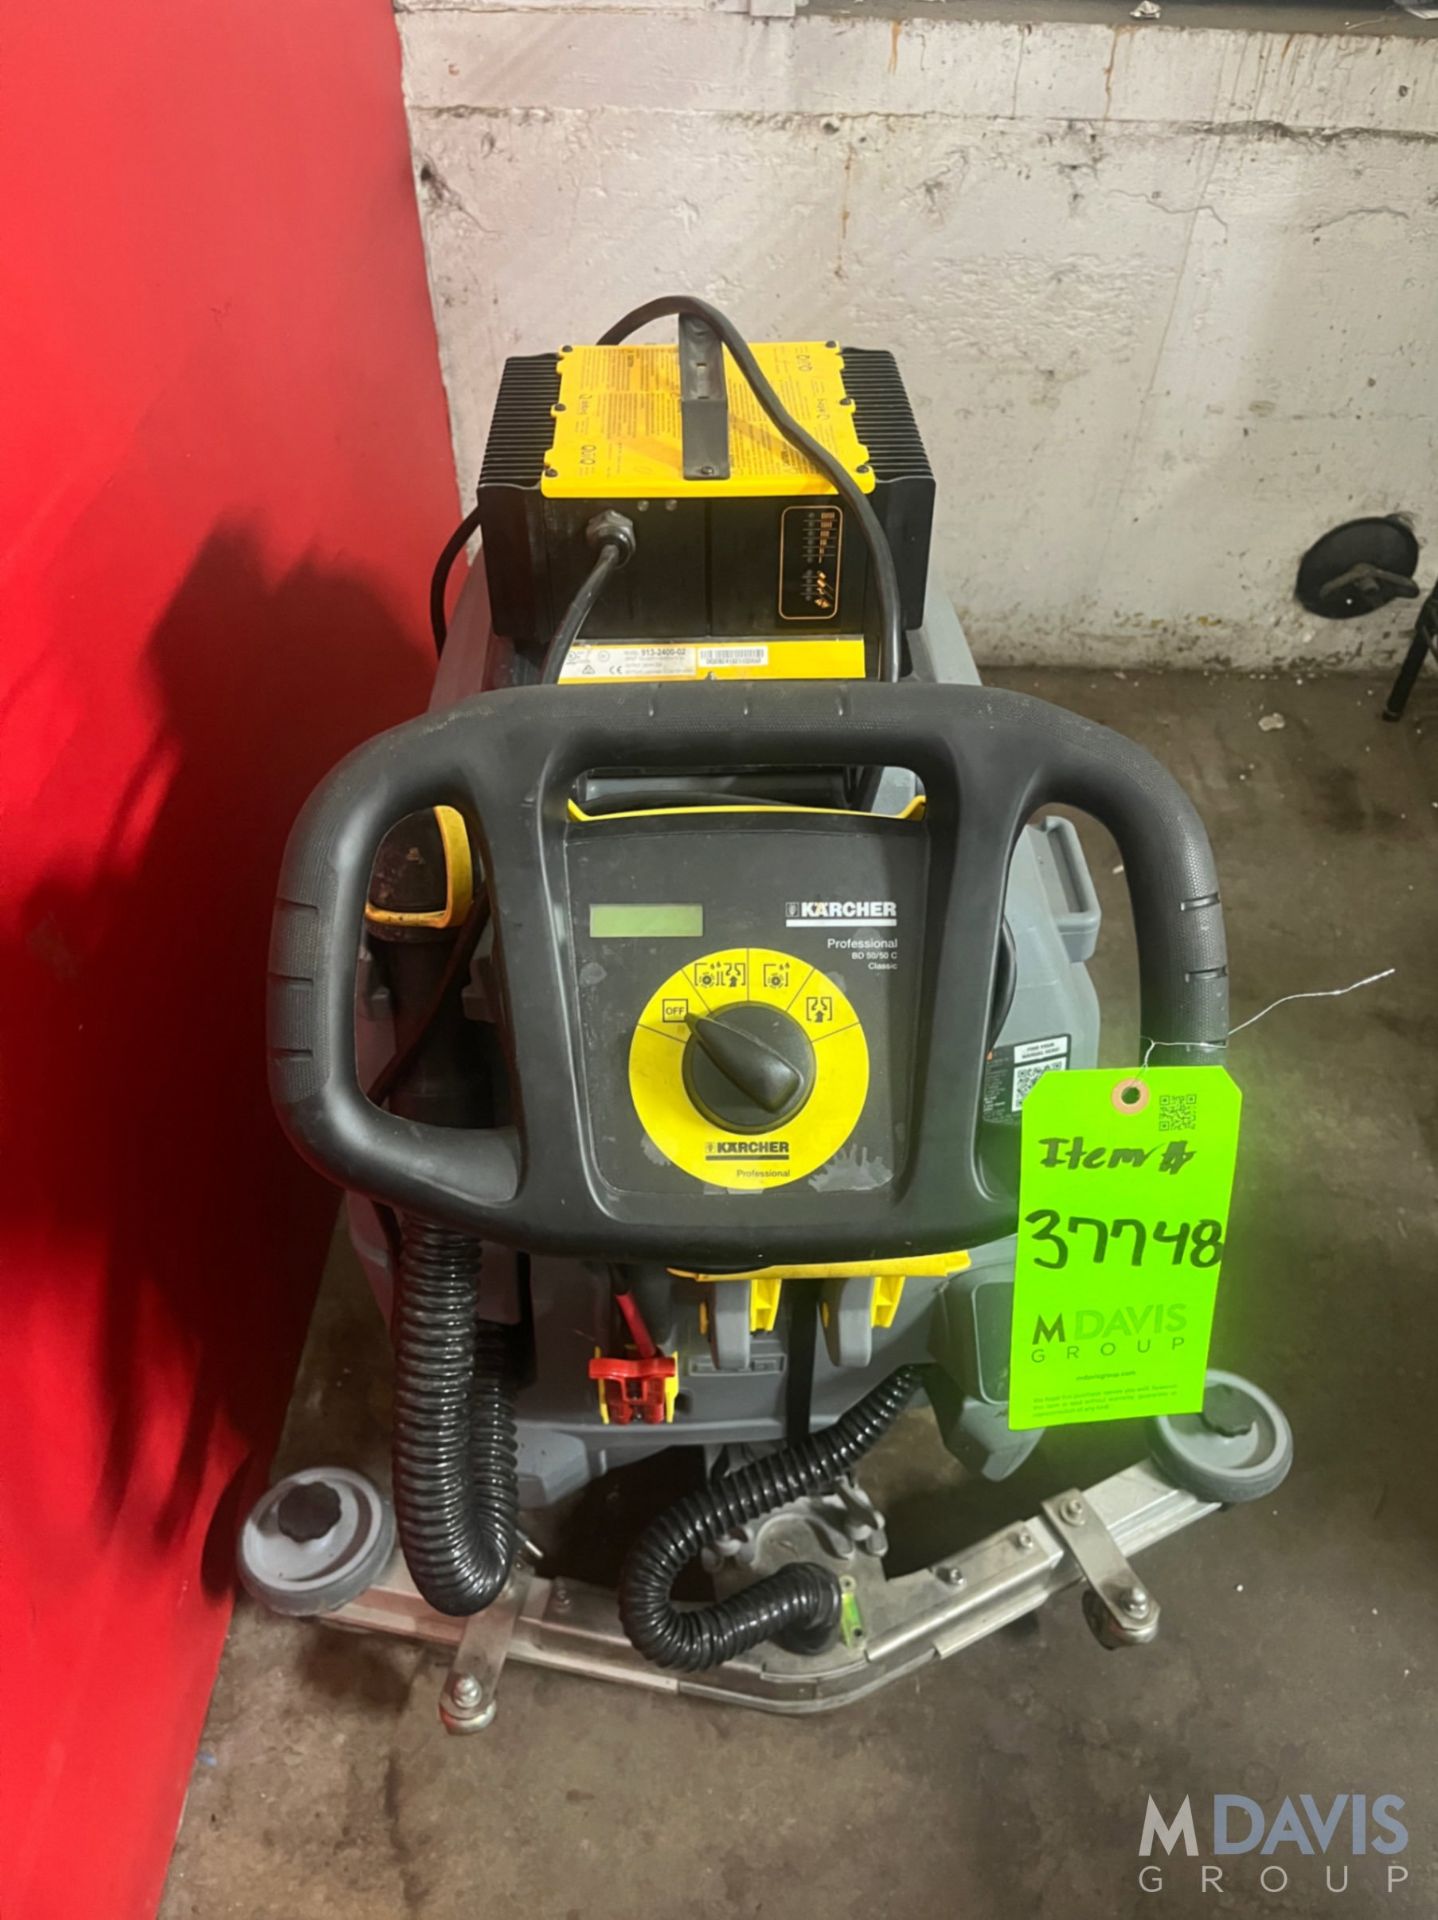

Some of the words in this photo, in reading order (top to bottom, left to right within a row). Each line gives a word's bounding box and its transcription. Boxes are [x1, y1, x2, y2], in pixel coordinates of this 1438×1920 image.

[801, 901, 897, 917] KÄRCHER
[827, 939, 898, 949] Professional
[868, 962, 898, 970] Classic
[665, 1006, 685, 1015] OFF
[1038, 1136, 1164, 1170] Item
[736, 1168, 790, 1178] Professional
[1025, 1209, 1224, 1269] 37748
[1032, 1312, 1066, 1345] M
[1074, 1303, 1187, 1341] DAVIS
[1031, 1337, 1185, 1364] GROUP
